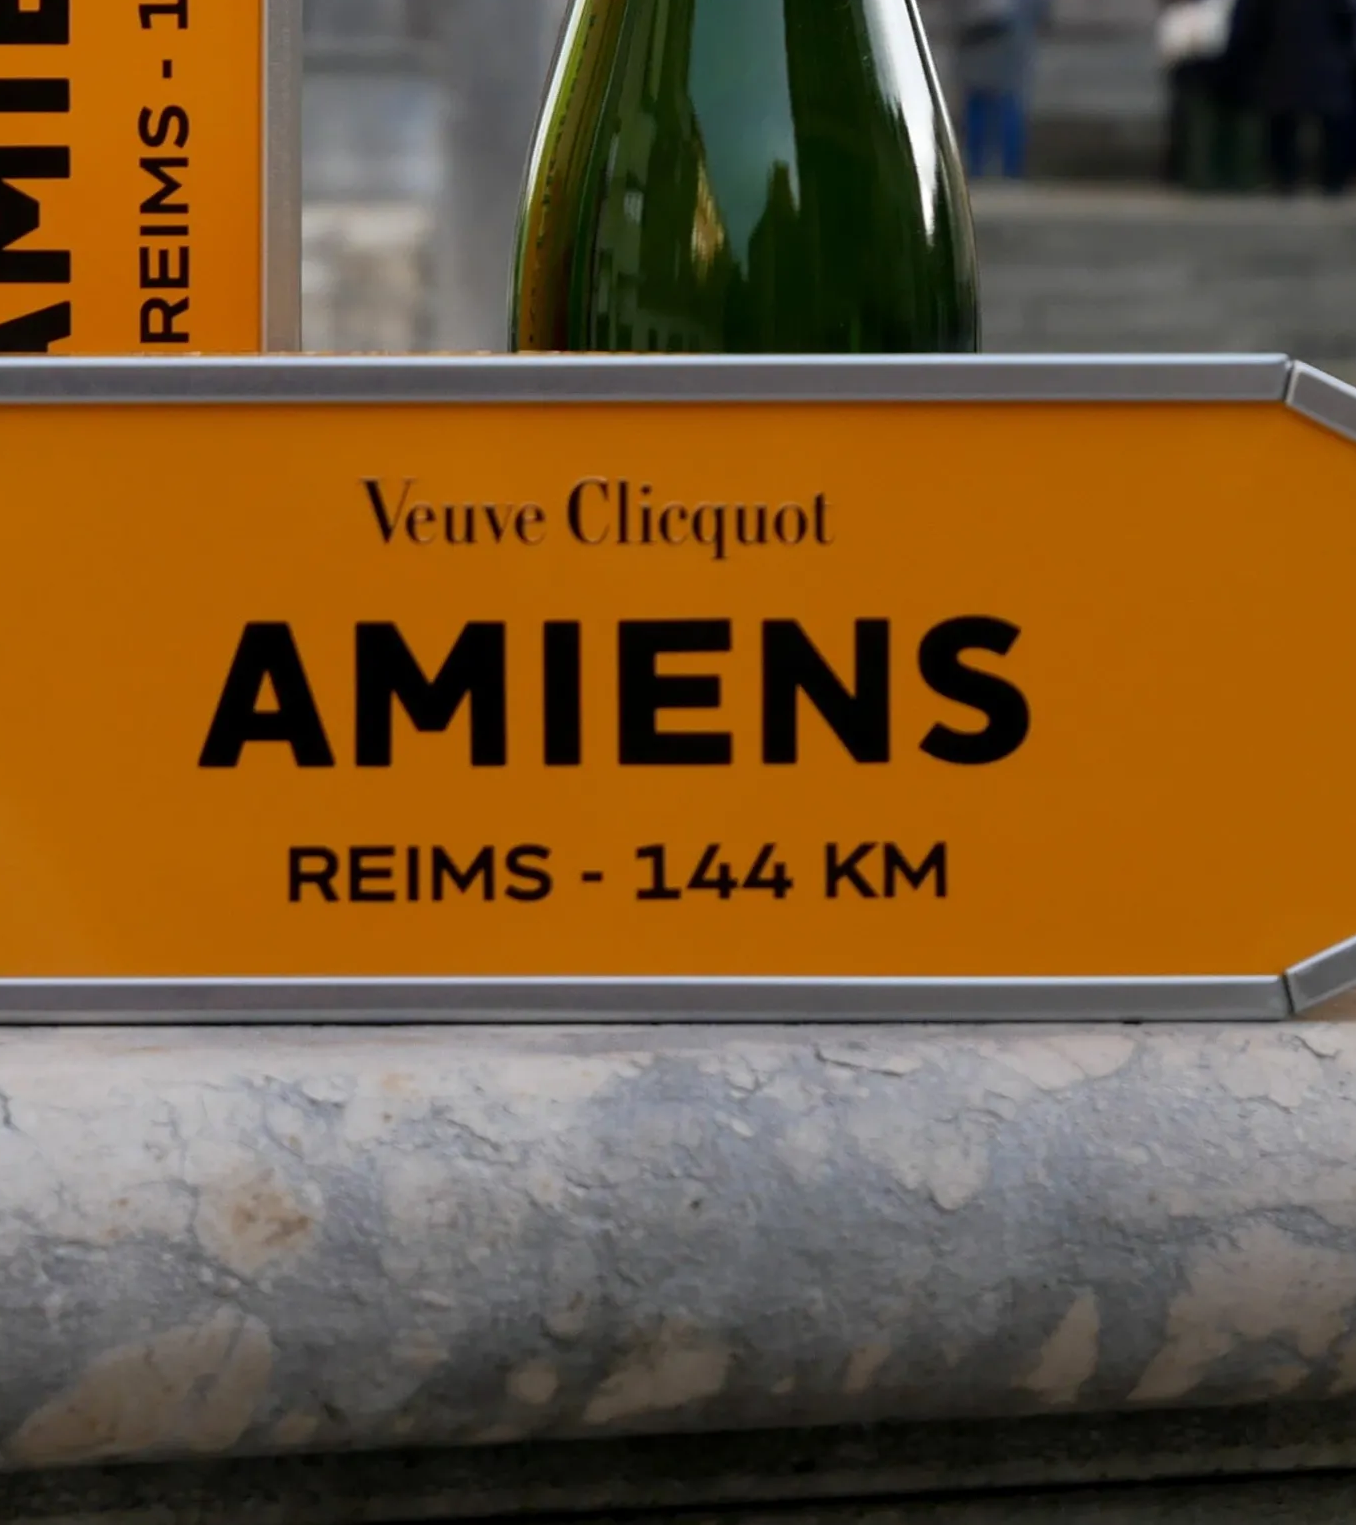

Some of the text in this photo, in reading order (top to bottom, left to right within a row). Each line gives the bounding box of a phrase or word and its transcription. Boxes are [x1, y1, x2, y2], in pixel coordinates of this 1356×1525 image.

[162, 59, 172, 79] -
[138, 105, 190, 343] REIMS
[360, 477, 834, 560] Veuve Clicquot
[198, 615, 1031, 768] AMIENS
[288, 842, 948, 903] REIMS - 144 KM
